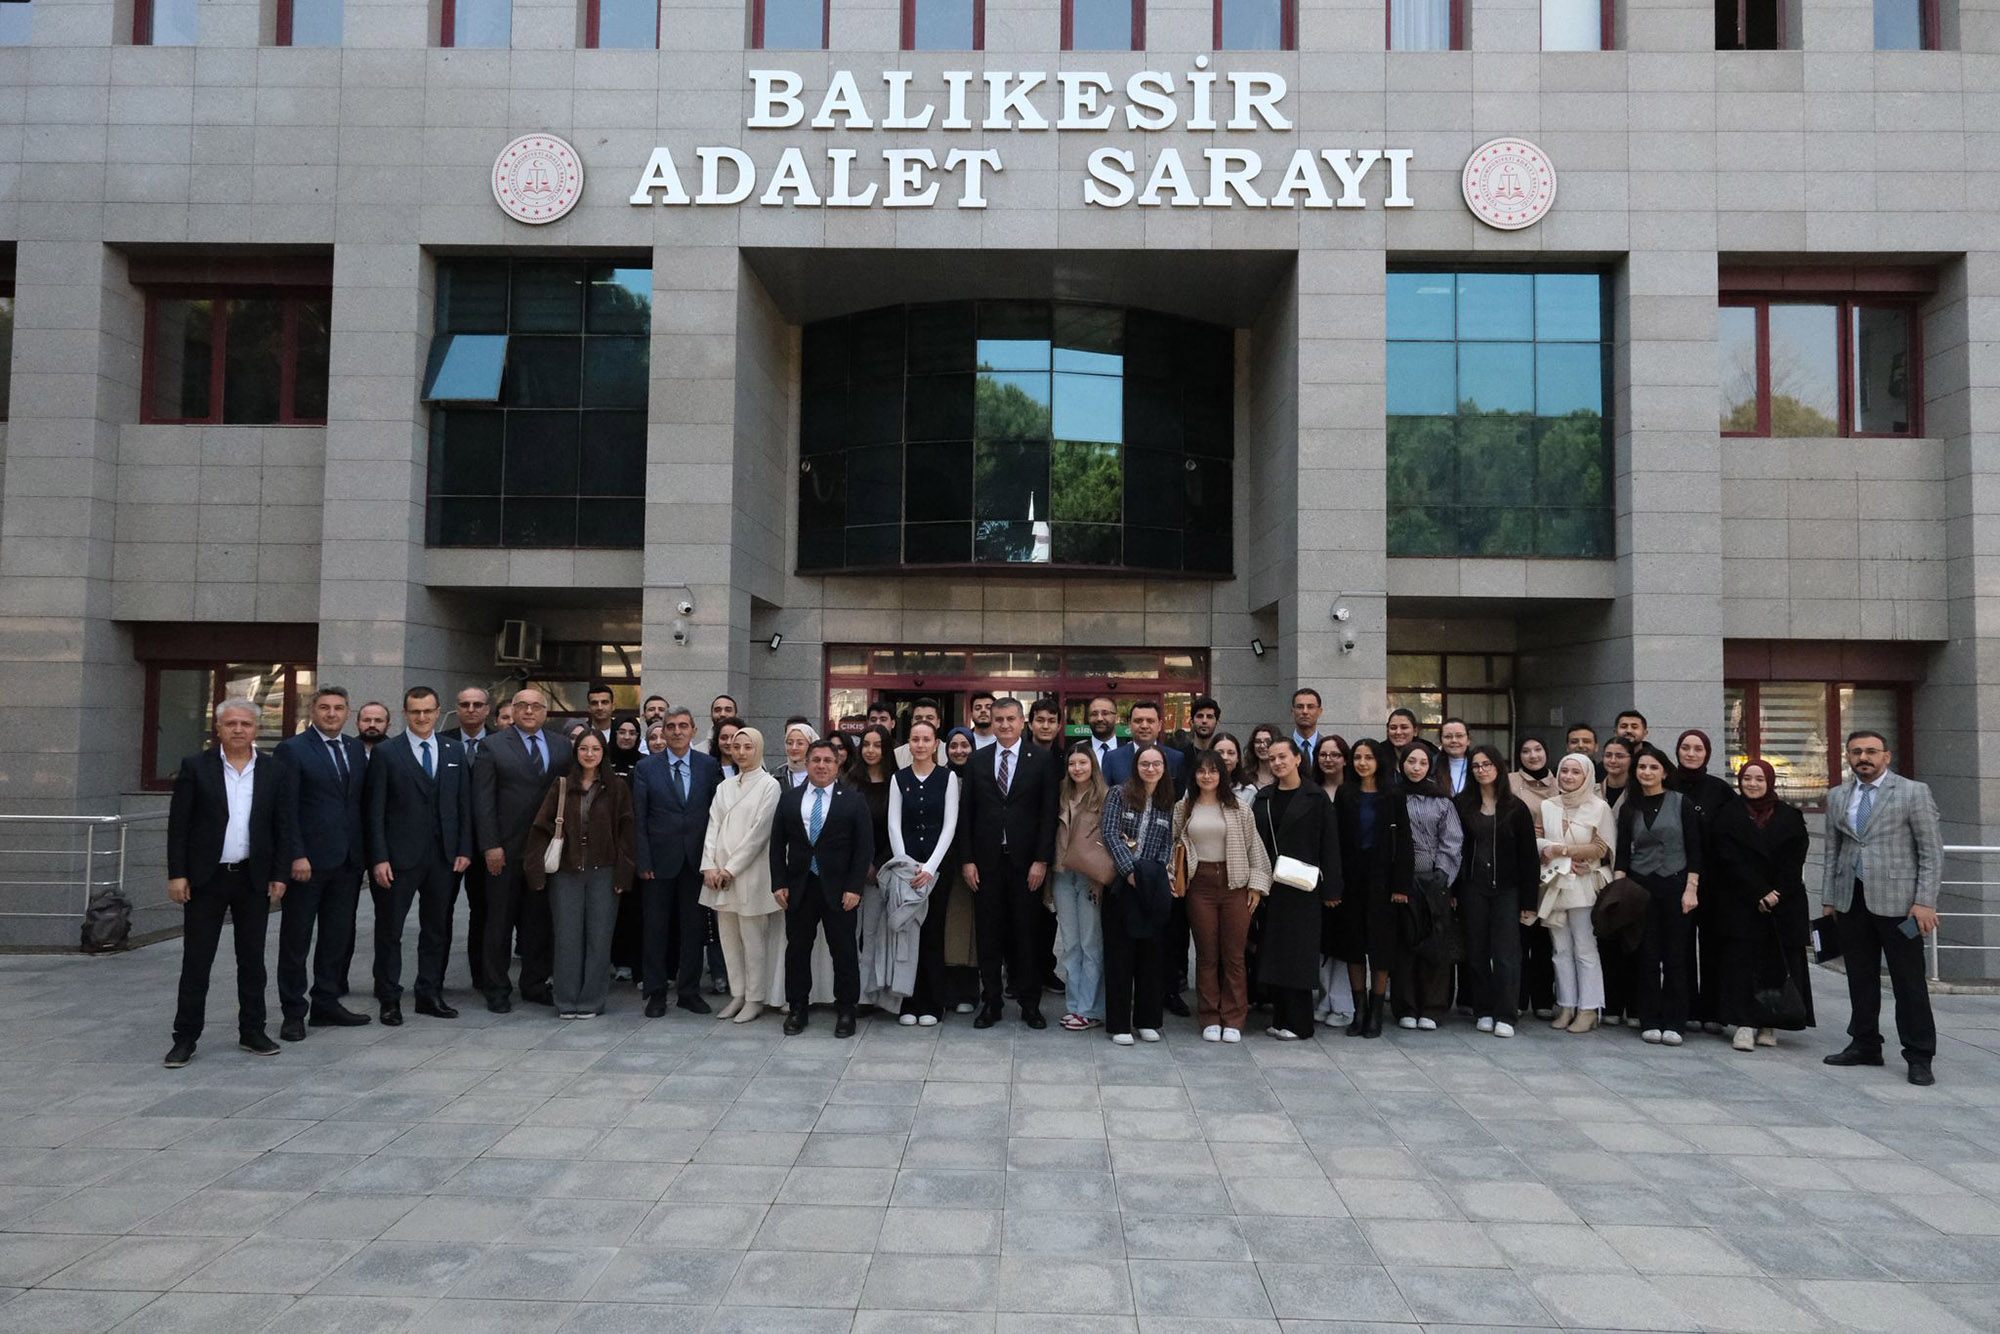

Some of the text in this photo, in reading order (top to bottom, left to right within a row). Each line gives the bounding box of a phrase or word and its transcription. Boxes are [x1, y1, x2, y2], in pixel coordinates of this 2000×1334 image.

[747, 55, 1293, 130] BALIKESİR
[630, 147, 1414, 208] ADALET SARAYI
